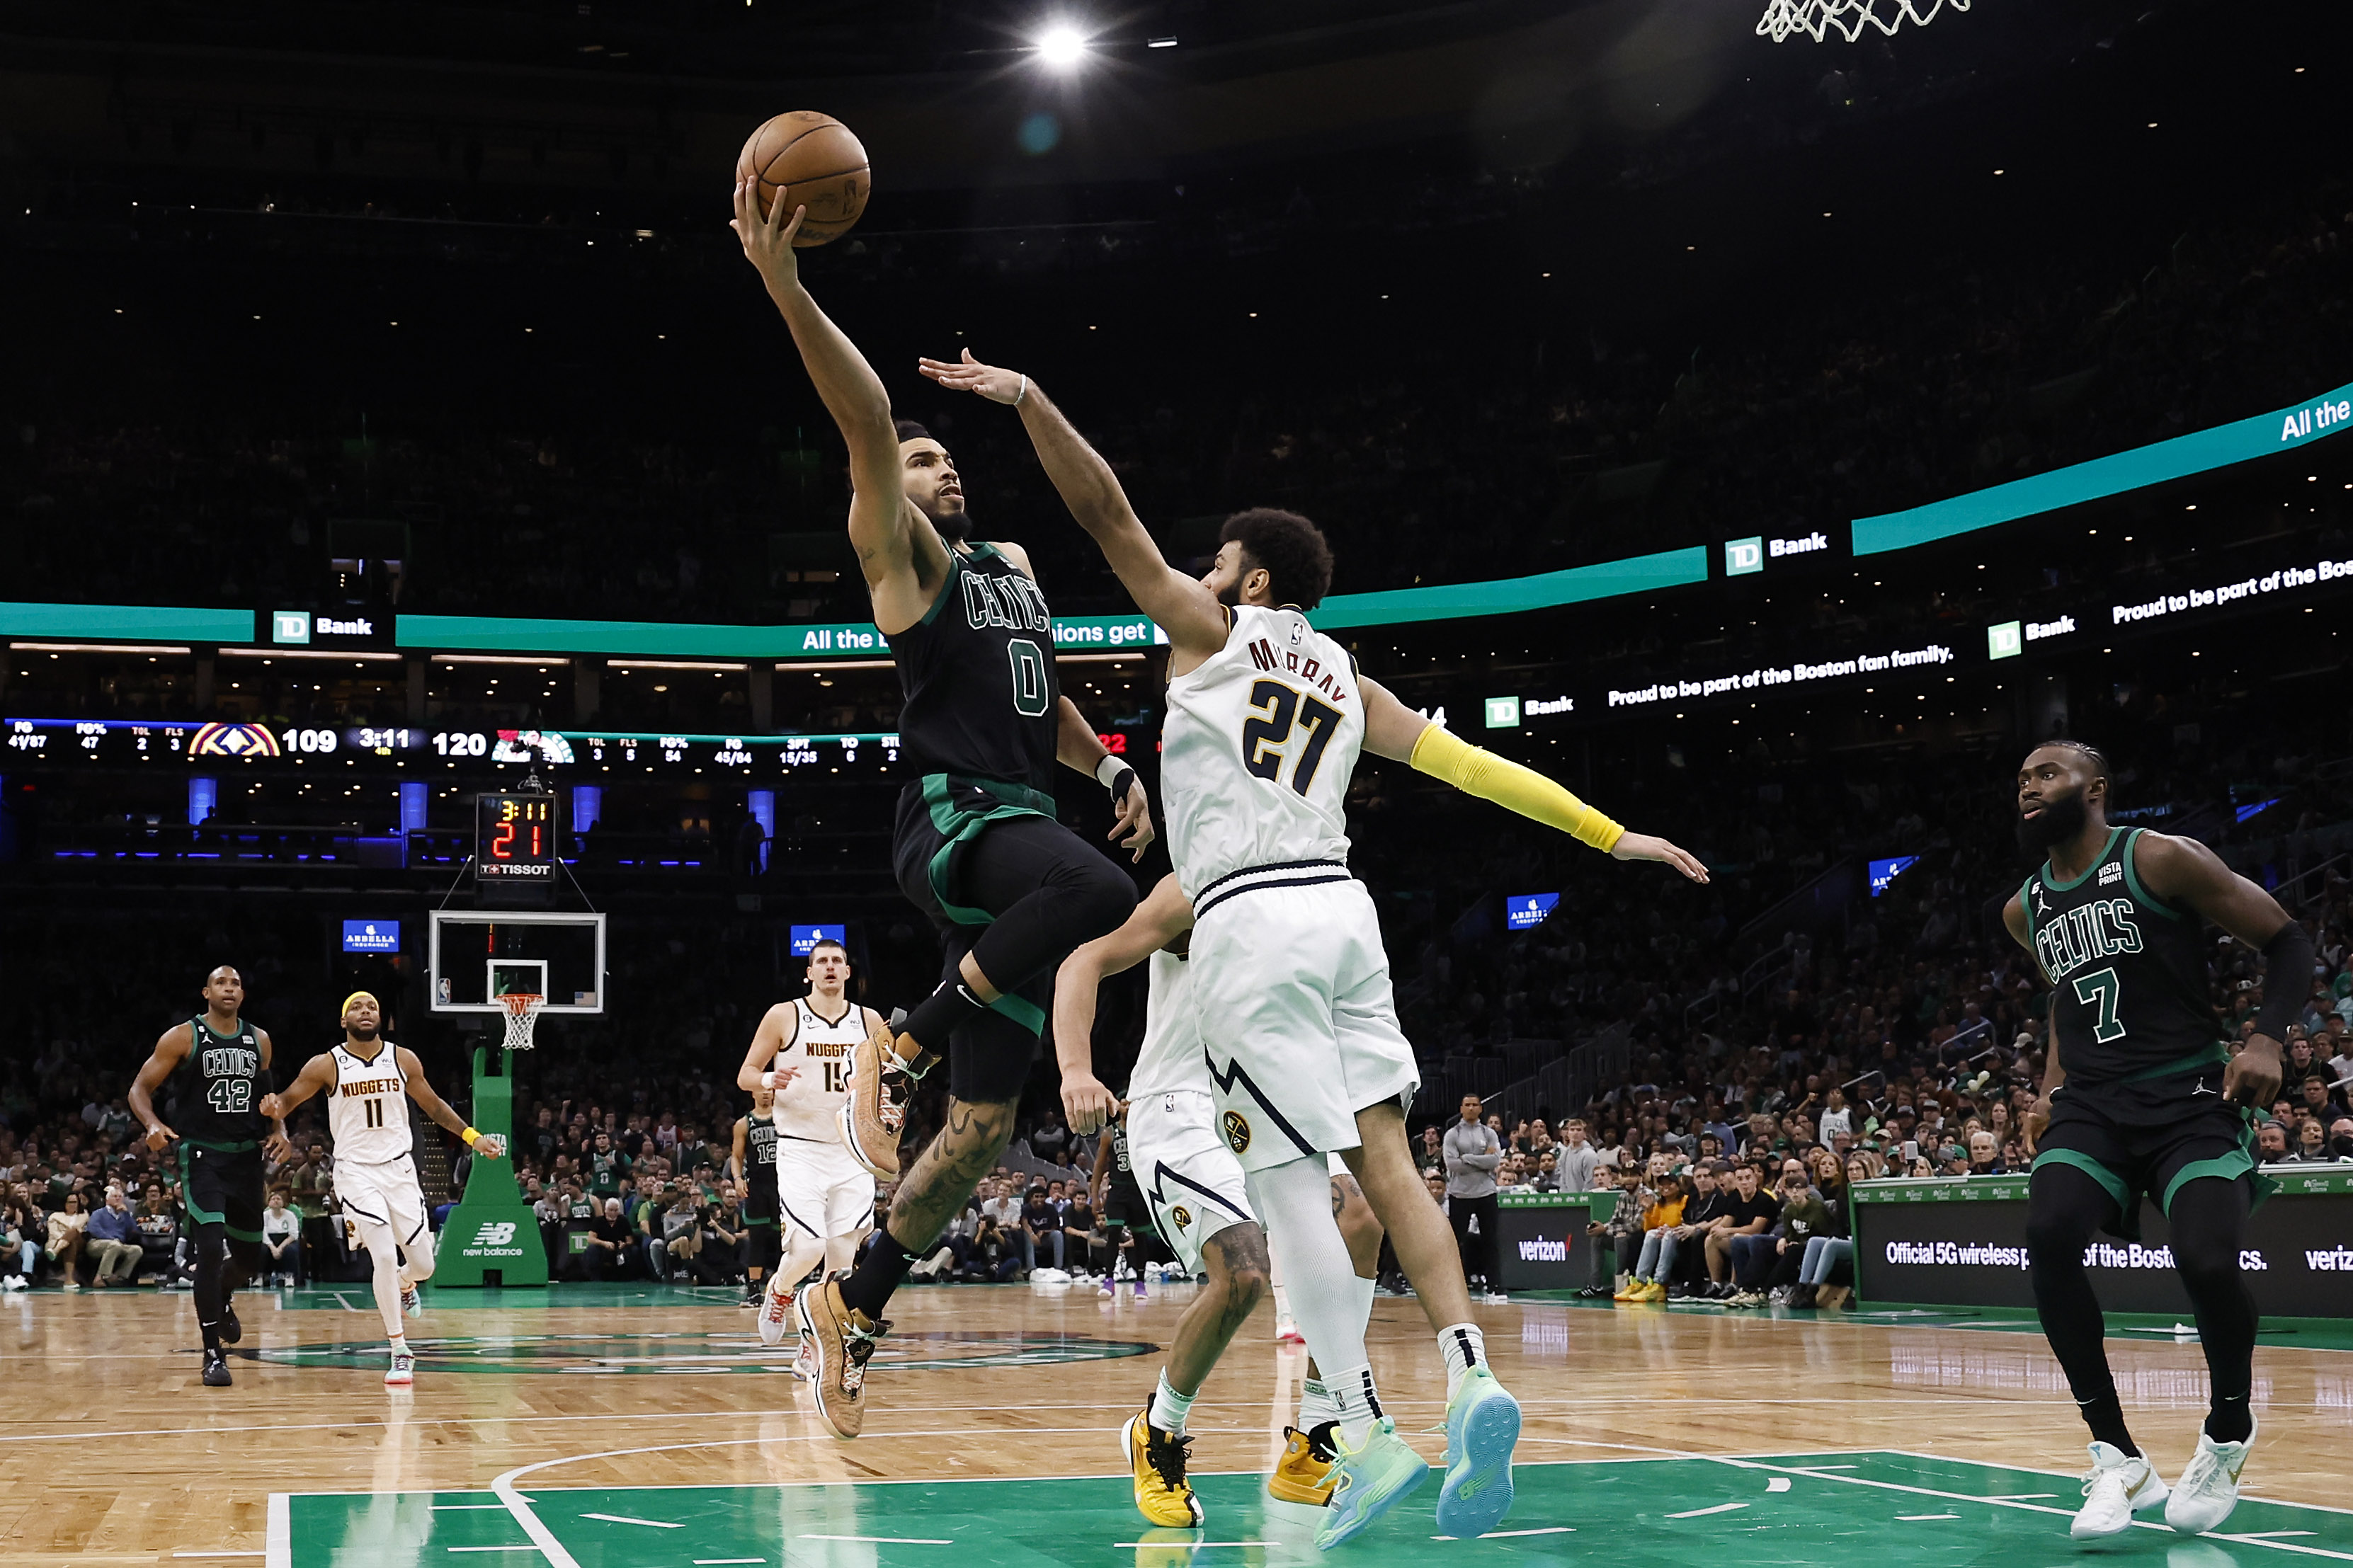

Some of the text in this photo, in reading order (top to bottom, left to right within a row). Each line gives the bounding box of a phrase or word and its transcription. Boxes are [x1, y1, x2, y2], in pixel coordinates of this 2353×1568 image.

[2281, 401, 2350, 441] All the
[1728, 532, 1828, 568] TD Bank
[2112, 596, 2166, 624] Proud
[2167, 596, 2188, 612] to
[2189, 589, 2215, 607] be
[2216, 578, 2258, 605] part
[2260, 571, 2281, 592] of
[2282, 568, 2316, 588] the
[277, 617, 372, 637] TD Bank
[1108, 622, 1146, 644] get
[1991, 615, 2075, 651] TD Bank
[802, 629, 831, 650] All
[836, 629, 872, 648] the
[1007, 638, 1048, 716] 0
[1608, 645, 1954, 706] Proud to be part of the Boston fan family.
[1488, 696, 1573, 722] TD Bank
[14, 721, 33, 733] FG
[76, 723, 107, 735] FG%
[165, 728, 183, 736] FLS
[359, 728, 409, 748] 3:11
[1243, 678, 1345, 798] 27
[81, 736, 99, 748] 47
[137, 738, 147, 750] 2
[171, 738, 180, 750] 3
[282, 728, 337, 752] 109
[375, 746, 391, 755] 4th
[432, 733, 486, 755] 120
[620, 738, 637, 747] FLS
[659, 737, 689, 748] FG%
[725, 738, 743, 750] FG
[787, 738, 810, 750] 3PT
[841, 737, 858, 748] TO
[593, 748, 896, 767] 3 5 54 45/84 15/35 6 2
[502, 801, 546, 820] 3:11
[493, 823, 541, 858] 21
[500, 864, 550, 875] TISSOT
[2098, 862, 2121, 879] VISTA
[2099, 871, 2123, 886] PRINT
[2032, 882, 2041, 895] 6
[2036, 898, 2143, 985] CELTICS
[2072, 966, 2126, 1043] 7
[203, 1048, 257, 1078] CELTICS
[207, 1079, 251, 1112] 42
[341, 1078, 399, 1098] NUGGETS
[364, 1098, 383, 1128] 11
[757, 1143, 777, 1164] 12
[1117, 1153, 1130, 1172] 3
[463, 1247, 523, 1257] new balance
[1519, 1235, 1566, 1261] verizon
[1886, 1242, 1935, 1264] Official
[1936, 1242, 1957, 1265] 5G
[1958, 1242, 2019, 1266] wireless
[2083, 1242, 2097, 1266] of
[2099, 1243, 2128, 1268] the
